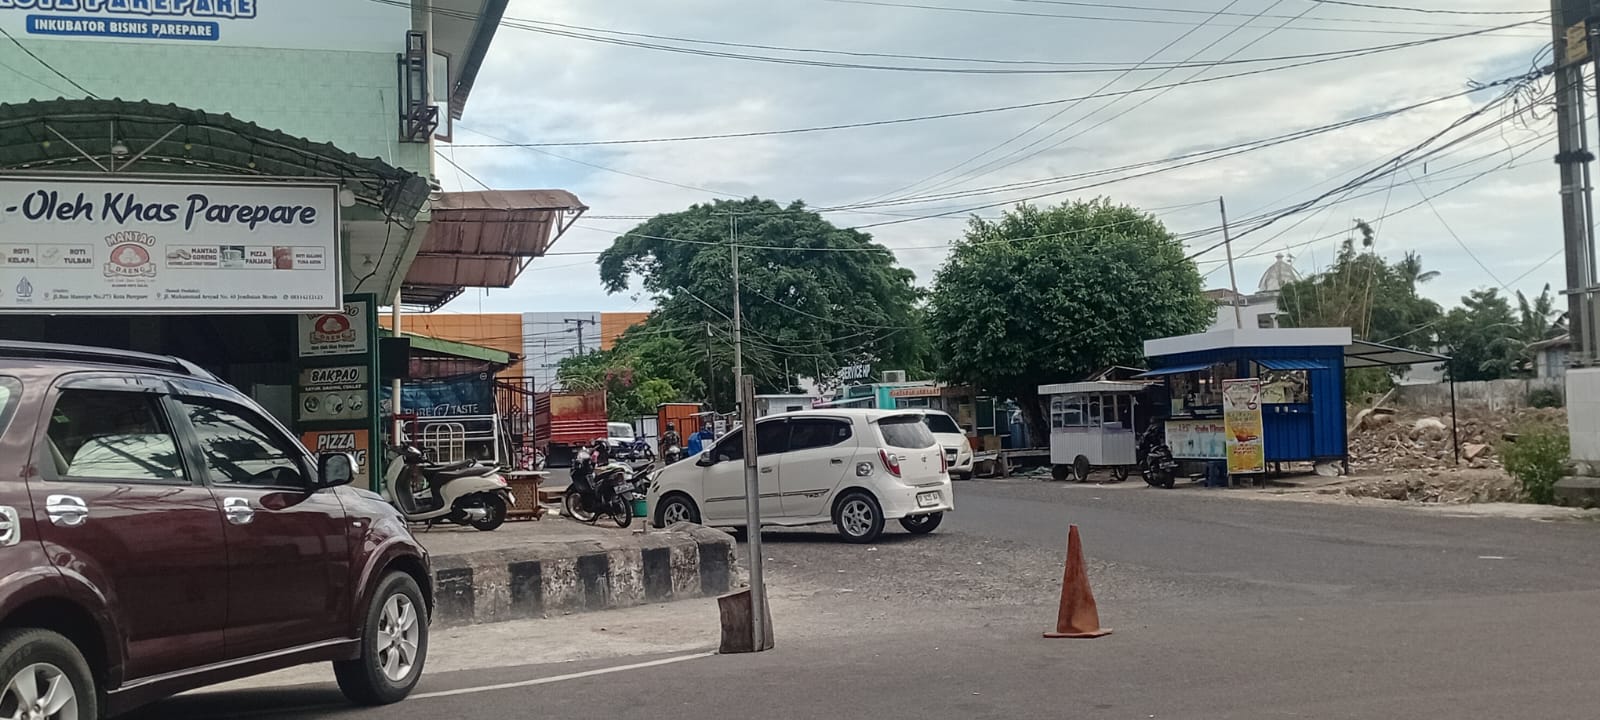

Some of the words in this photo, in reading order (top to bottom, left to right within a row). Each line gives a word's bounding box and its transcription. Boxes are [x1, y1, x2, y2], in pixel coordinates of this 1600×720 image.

[34, 18, 105, 32] INKUBATOR
[109, 21, 148, 34] BISNIS
[151, 23, 212, 36] PAREPARE
[102, 193, 179, 224] Khas
[184, 194, 316, 231] Parepare
[105, 231, 156, 247] MANTAO
[115, 266, 146, 274] DAENG
[311, 368, 359, 382] BAKPAO
[451, 403, 479, 414] TASTE
[317, 433, 356, 449] PIZZA
